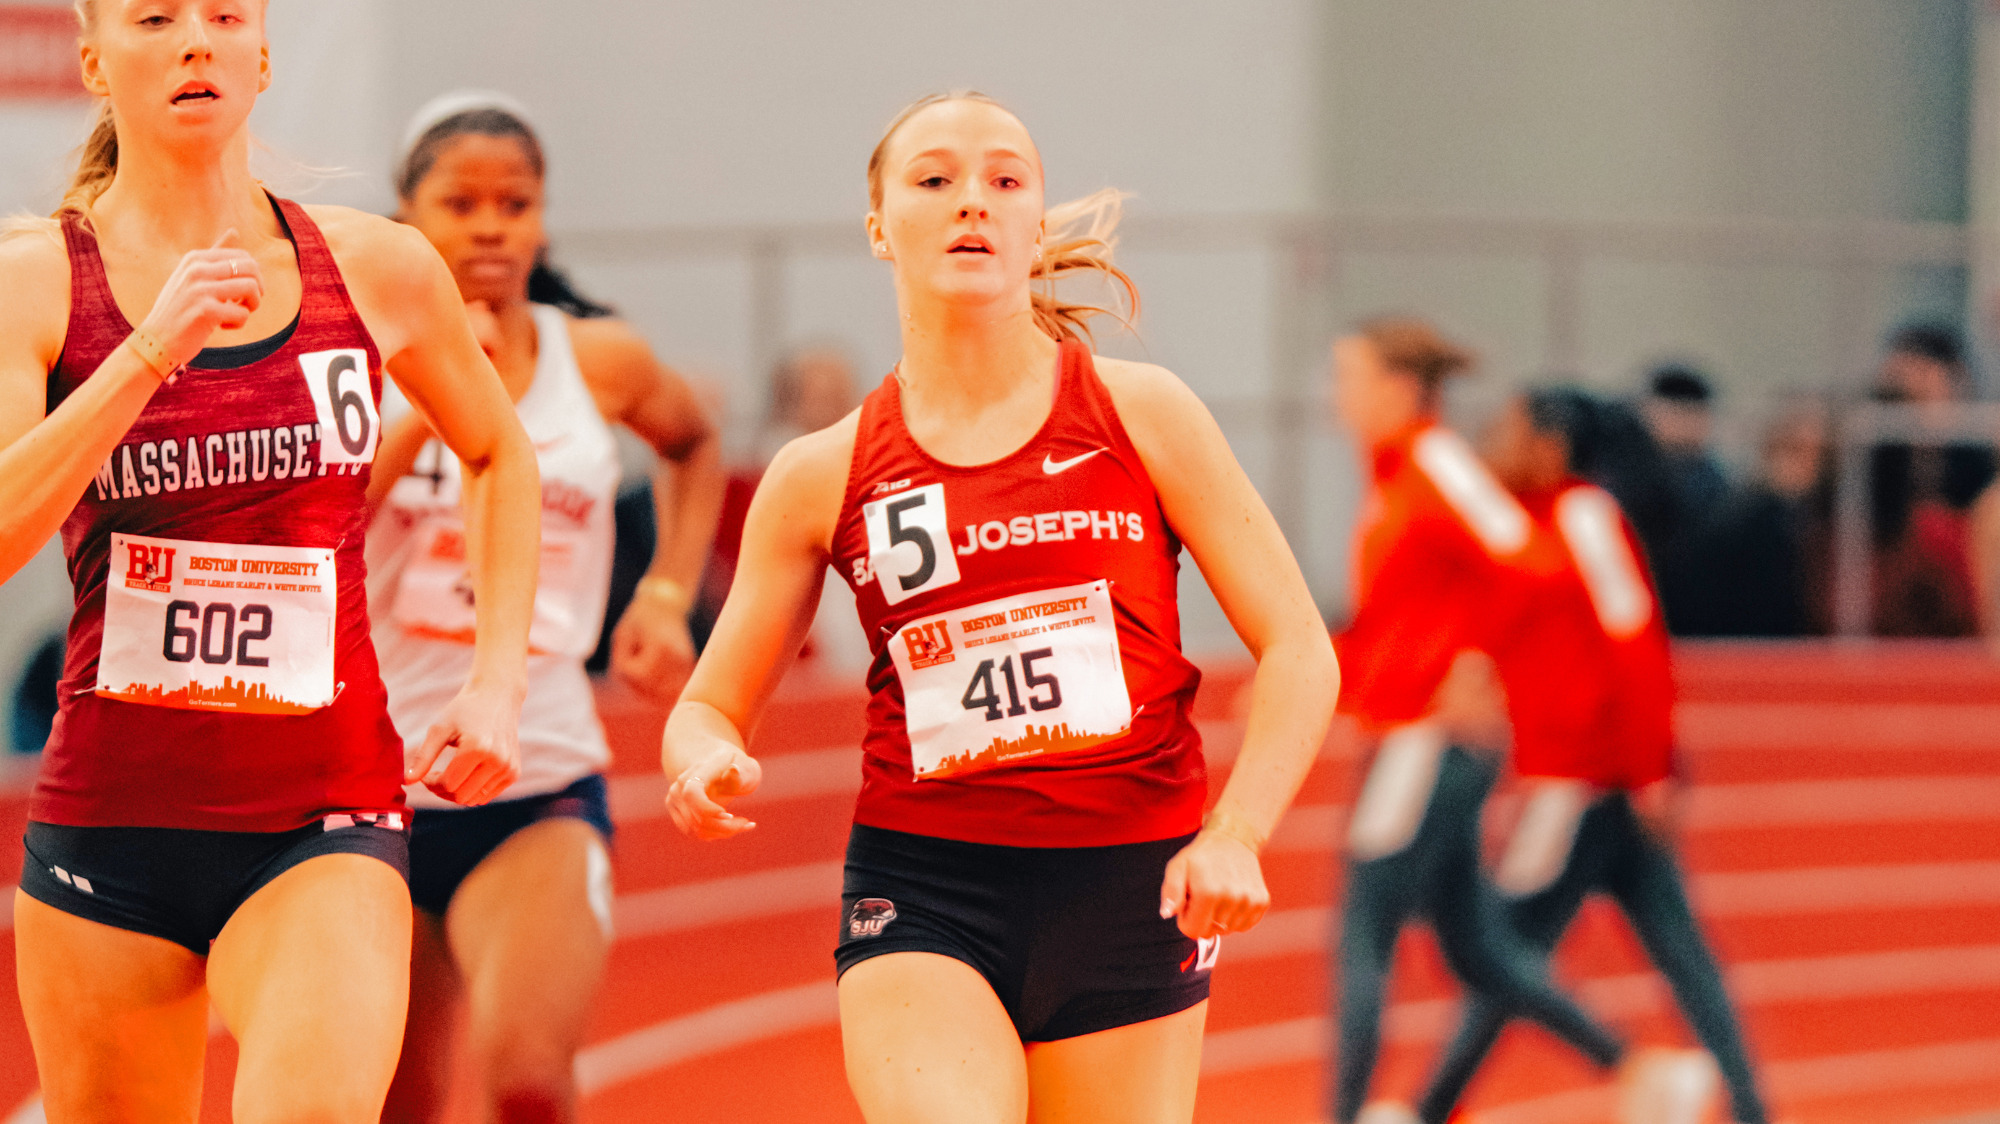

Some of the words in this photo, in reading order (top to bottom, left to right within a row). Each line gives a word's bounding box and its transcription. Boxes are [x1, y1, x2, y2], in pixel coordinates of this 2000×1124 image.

[327, 354, 371, 457] 6
[95, 422, 363, 501] MASSACHUSE
[886, 492, 936, 591] 5
[957, 510, 1144, 555] JOSEPH'S
[126, 543, 176, 583] BU
[189, 556, 238, 572] BOSTON
[241, 559, 319, 576] UNIVERSITY
[183, 578, 206, 587] BRUCE
[236, 581, 266, 590] SCARLET
[274, 583, 297, 592] WHITE
[298, 585, 322, 593] INVITE
[163, 599, 273, 667] 602
[960, 611, 1007, 633] BOSTON
[1009, 596, 1088, 622] UNIVERSITY
[963, 638, 985, 649] BRUCE
[1010, 626, 1040, 639] SCARLET
[1048, 620, 1071, 631] WHITE
[1071, 616, 1096, 627] INVITE
[901, 619, 954, 663] BU
[188, 699, 237, 707] GoTerriers.com
[961, 646, 1063, 721] 415
[851, 920, 881, 935] SJU
